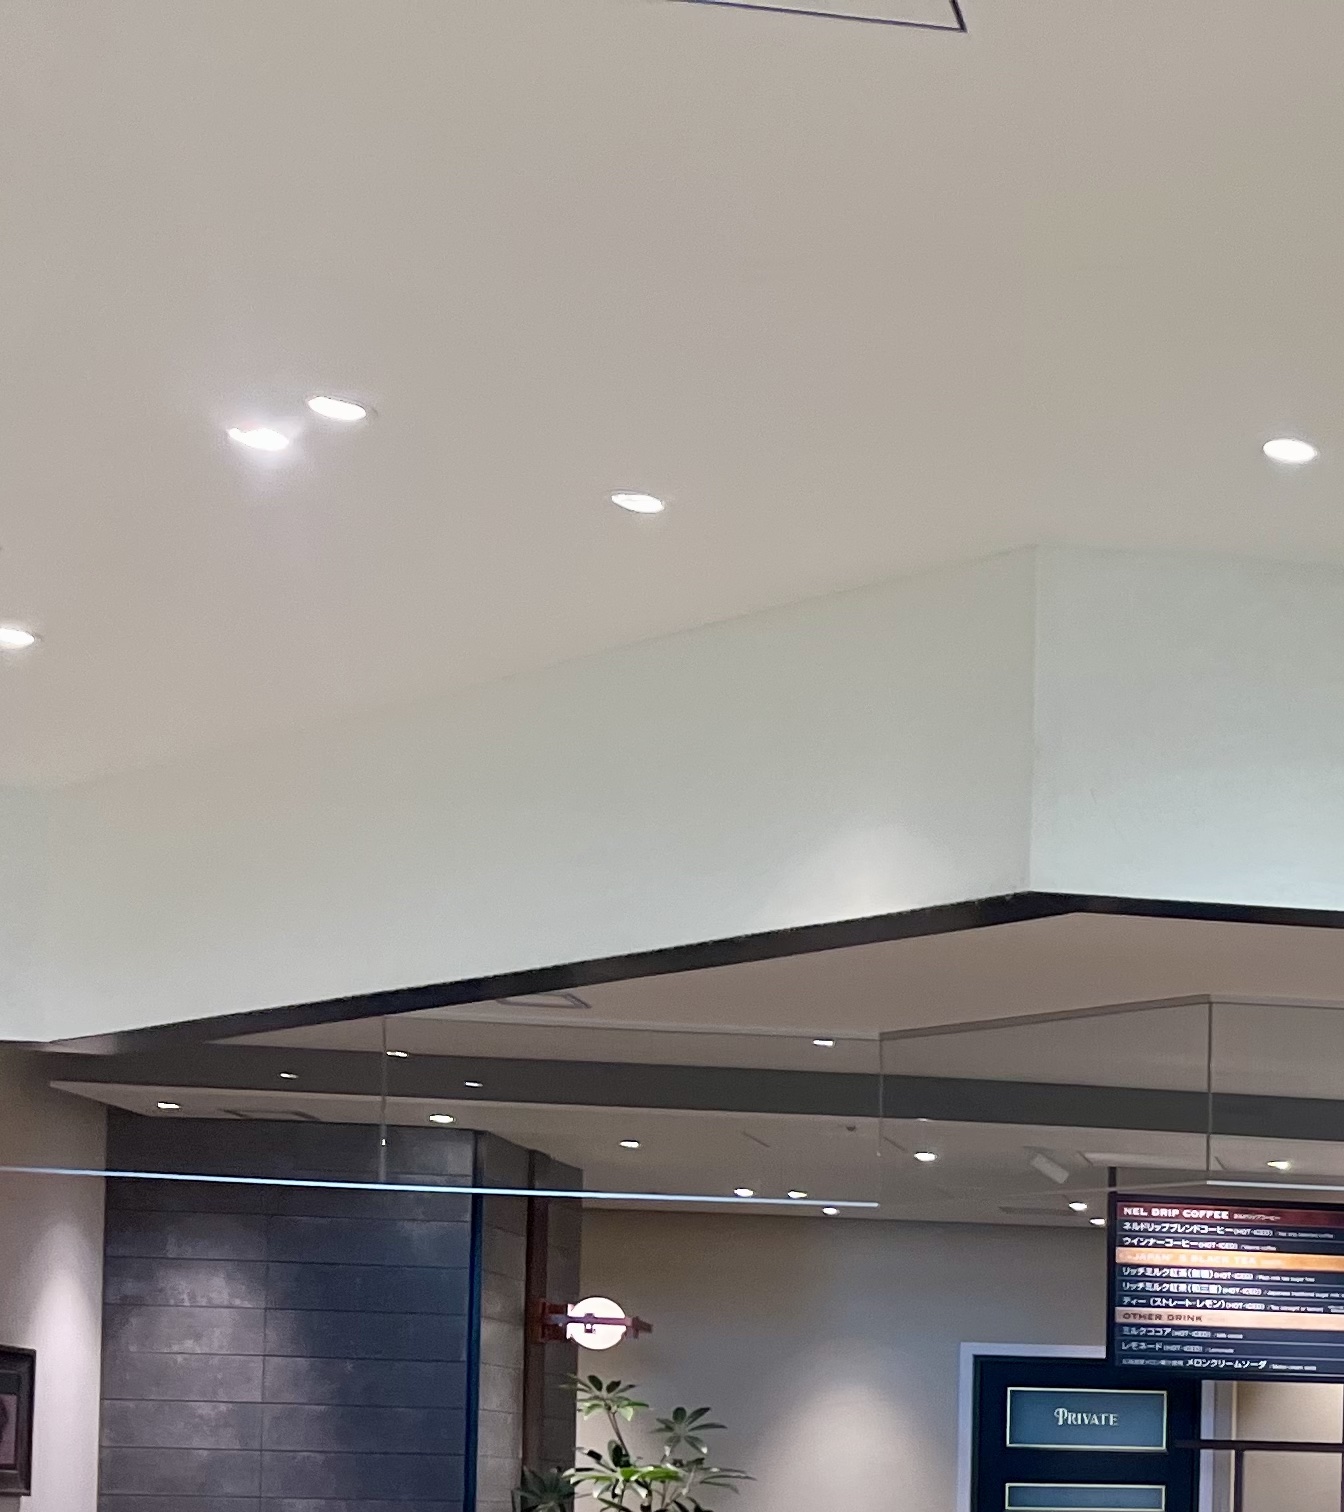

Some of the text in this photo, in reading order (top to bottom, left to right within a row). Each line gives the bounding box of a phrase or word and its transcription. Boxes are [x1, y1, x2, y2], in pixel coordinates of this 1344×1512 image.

[1123, 1207, 1230, 1220] NEL DRIP COFFEE
